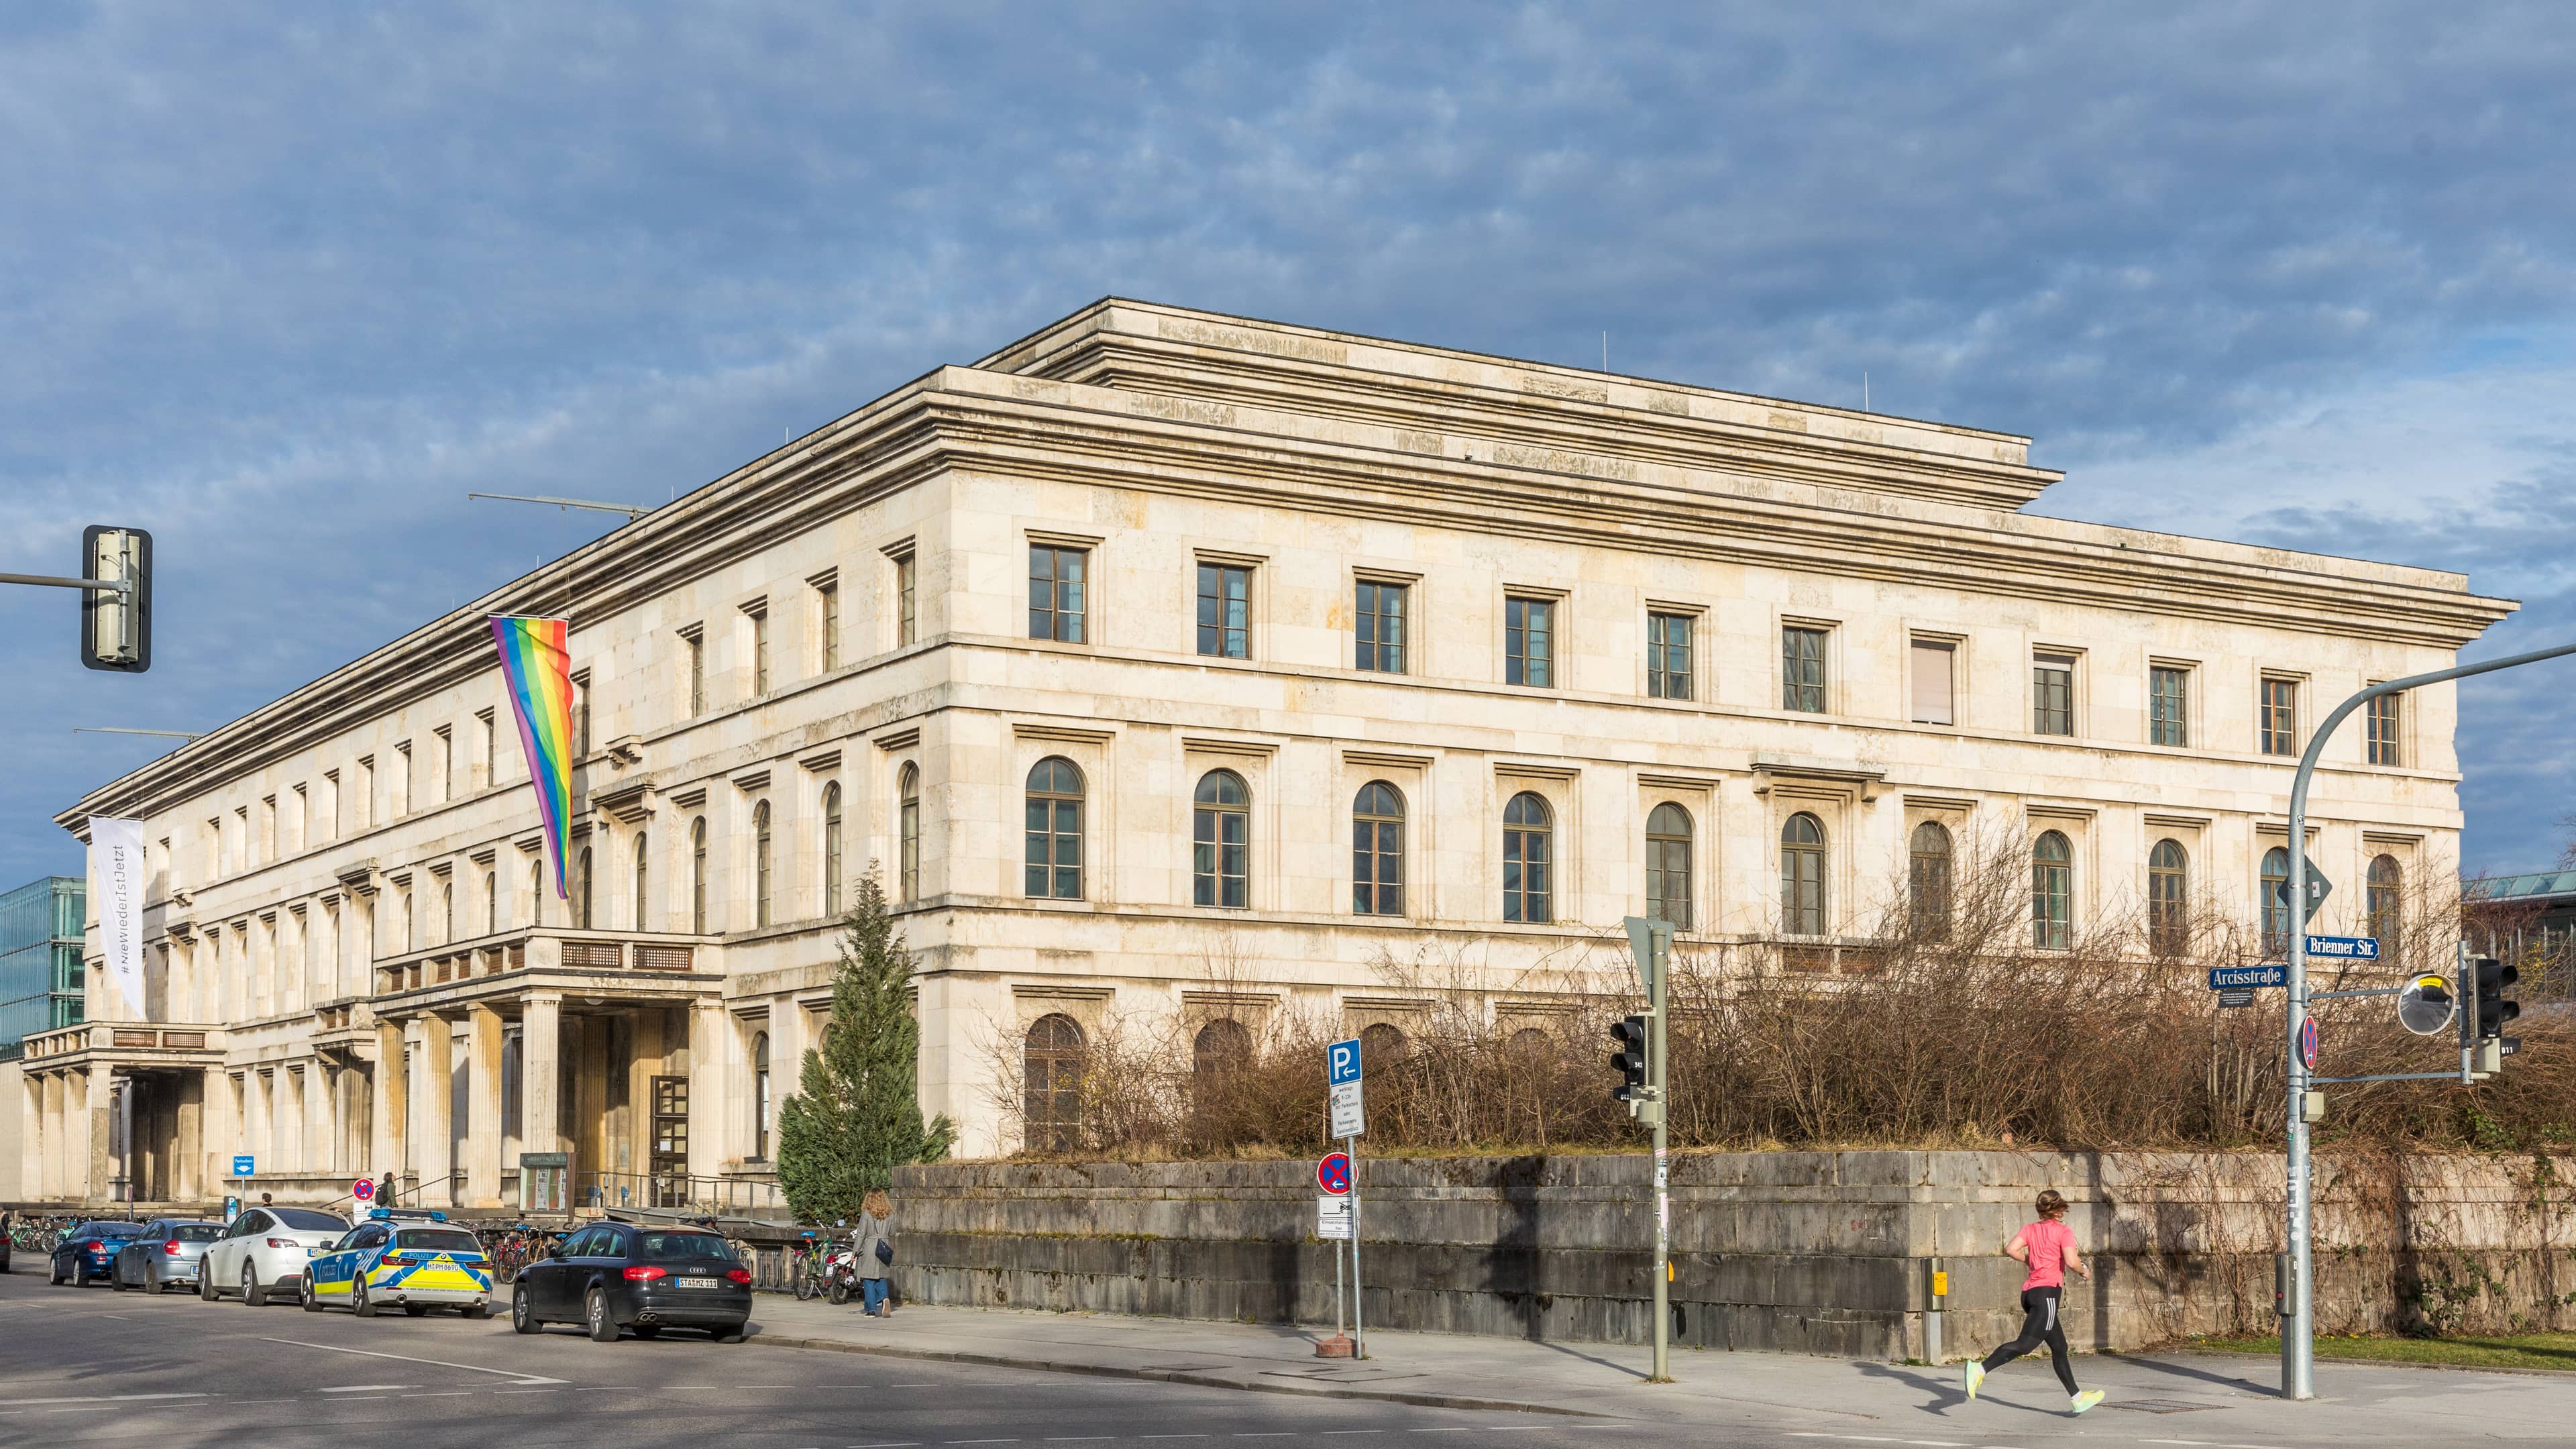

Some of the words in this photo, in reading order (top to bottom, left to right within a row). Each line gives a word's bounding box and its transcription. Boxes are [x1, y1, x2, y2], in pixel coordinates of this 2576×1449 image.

[2310, 938, 2354, 955] Brienner
[2357, 940, 2373, 955] Str.
[2214, 968, 2281, 985] Arcisstraße
[1334, 1047, 1351, 1079] P
